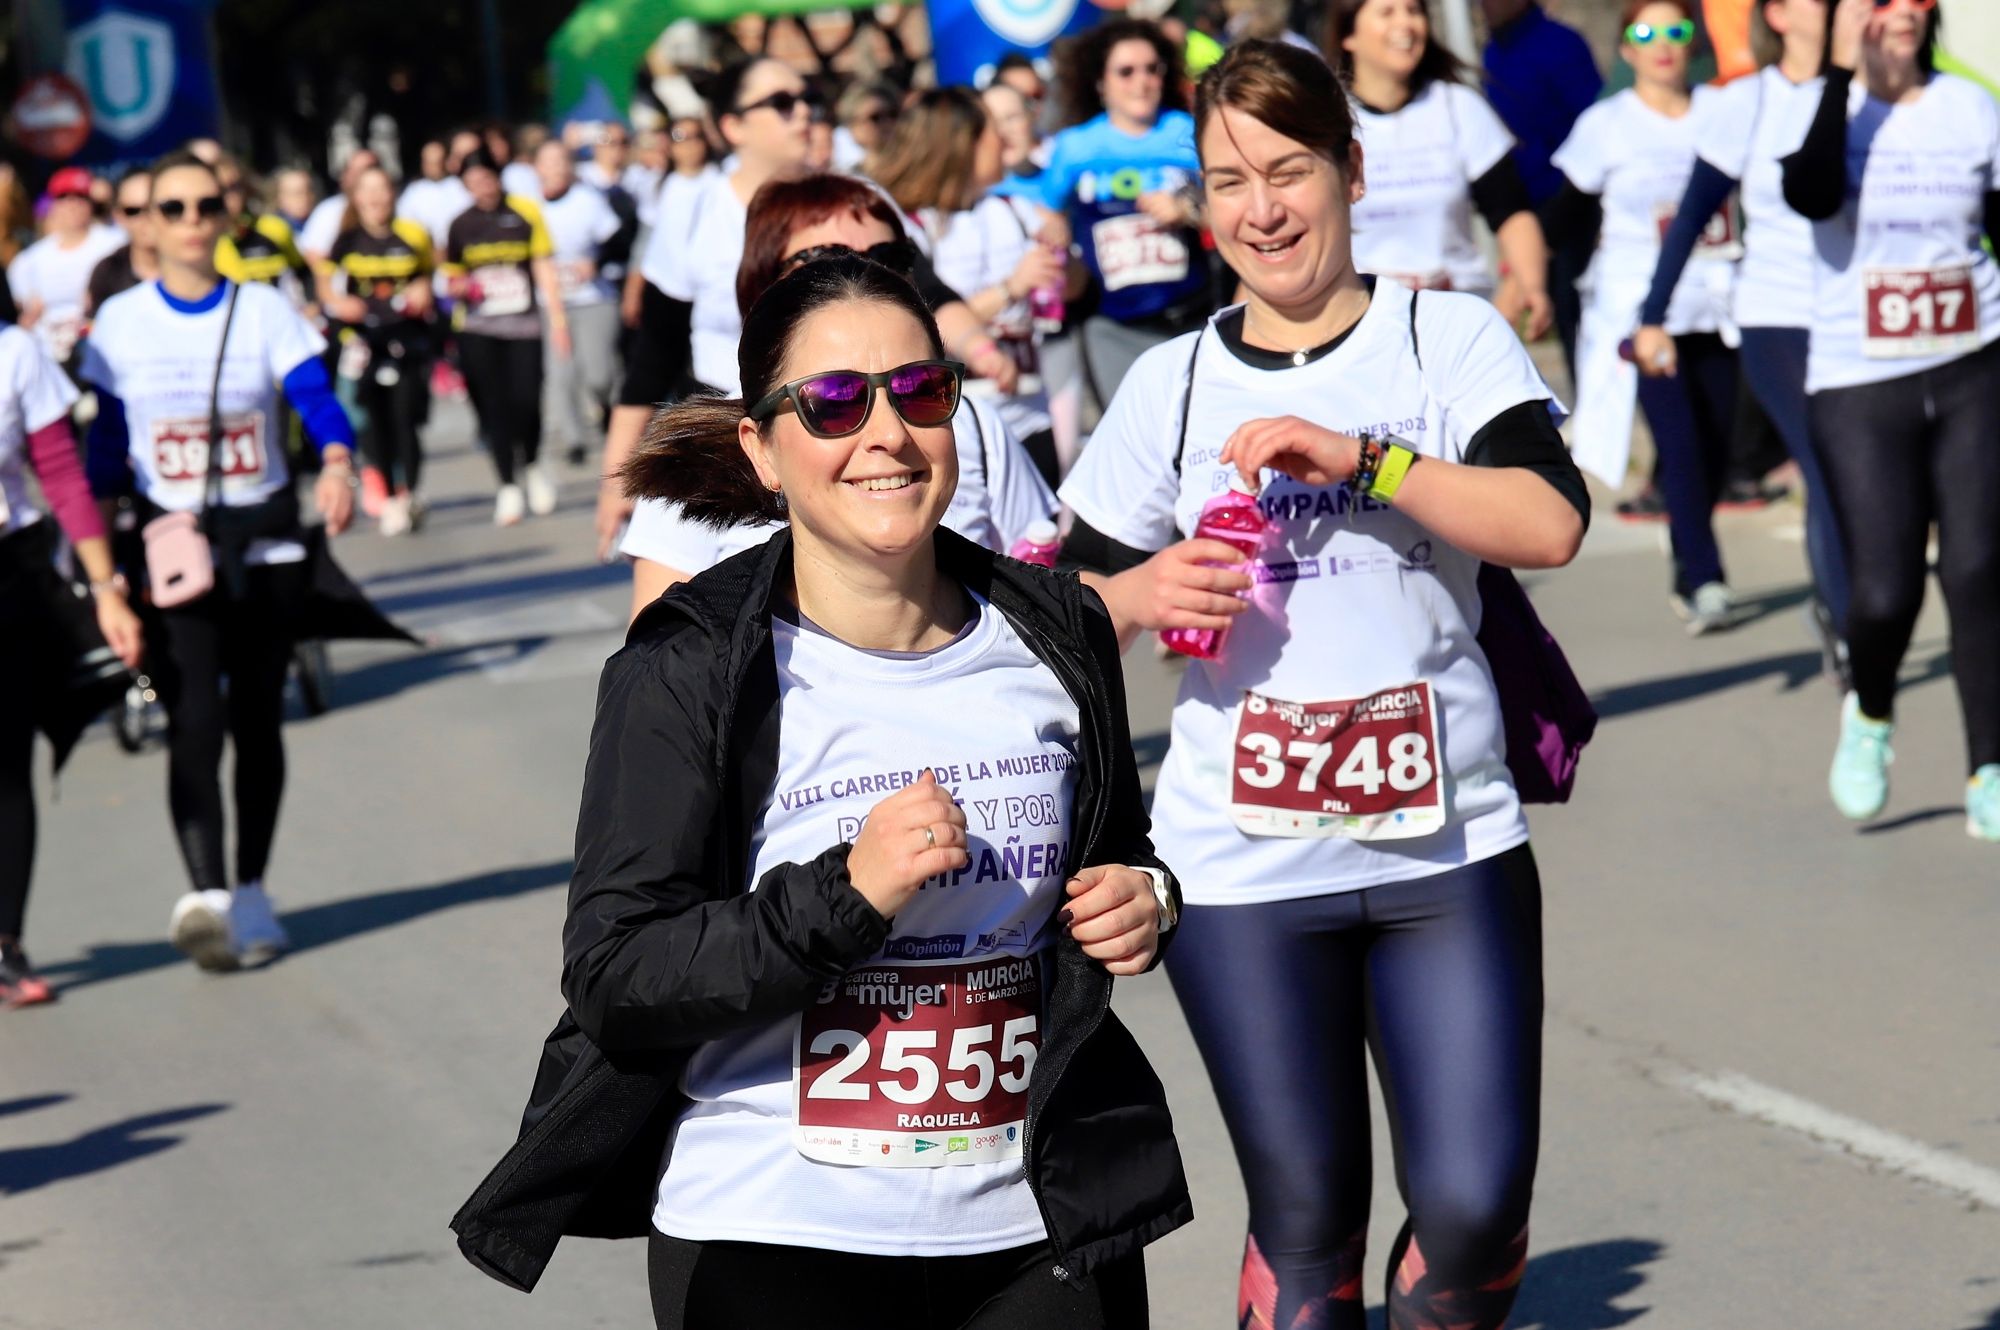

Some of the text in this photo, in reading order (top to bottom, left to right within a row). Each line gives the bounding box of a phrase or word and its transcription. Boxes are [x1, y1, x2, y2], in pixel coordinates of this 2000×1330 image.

[1878, 287, 1966, 333] 917
[778, 785, 825, 811] VIII
[934, 765, 962, 785] DE
[966, 761, 993, 781] LA
[996, 754, 1052, 778] MUJER
[1237, 731, 1434, 796] 3748
[974, 799, 998, 831] Y
[1005, 793, 1059, 829] POR
[1322, 799, 1351, 814] PILI
[919, 835, 1068, 891] PAÑERA
[966, 959, 1035, 992] MURCIA
[858, 983, 946, 1020] mujer
[966, 994, 972, 1005] 5
[975, 992, 987, 1003] DE
[988, 988, 1018, 1001] MARZO
[806, 1014, 1038, 1105] 2555
[898, 1111, 981, 1128] RAQUELA
